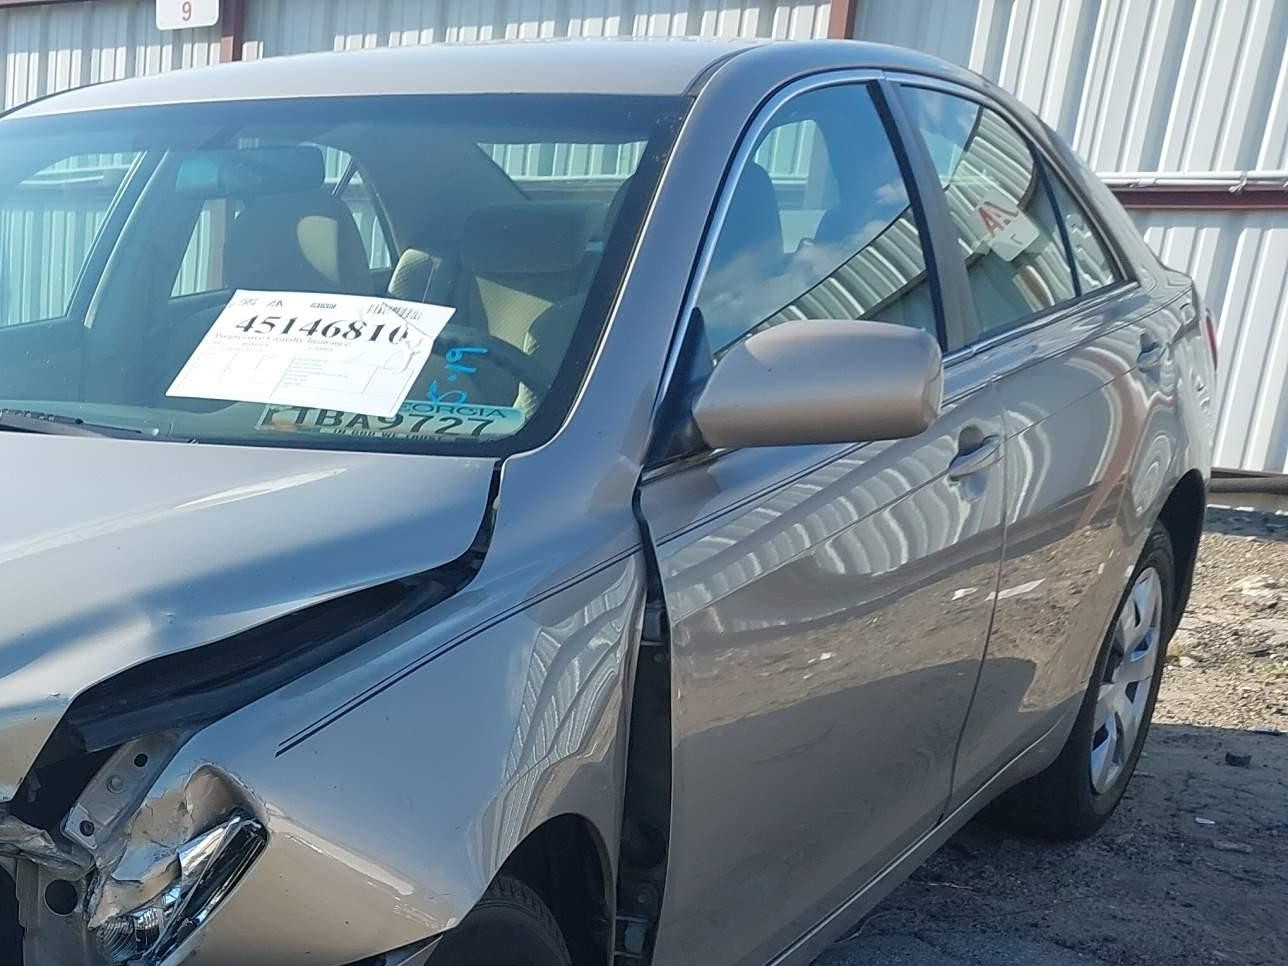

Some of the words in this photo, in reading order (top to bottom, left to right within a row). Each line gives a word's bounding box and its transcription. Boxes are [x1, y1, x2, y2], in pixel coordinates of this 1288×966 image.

[181, 1, 192, 21] 9
[235, 315, 409, 345] 45146810
[401, 402, 507, 419] EORGIA
